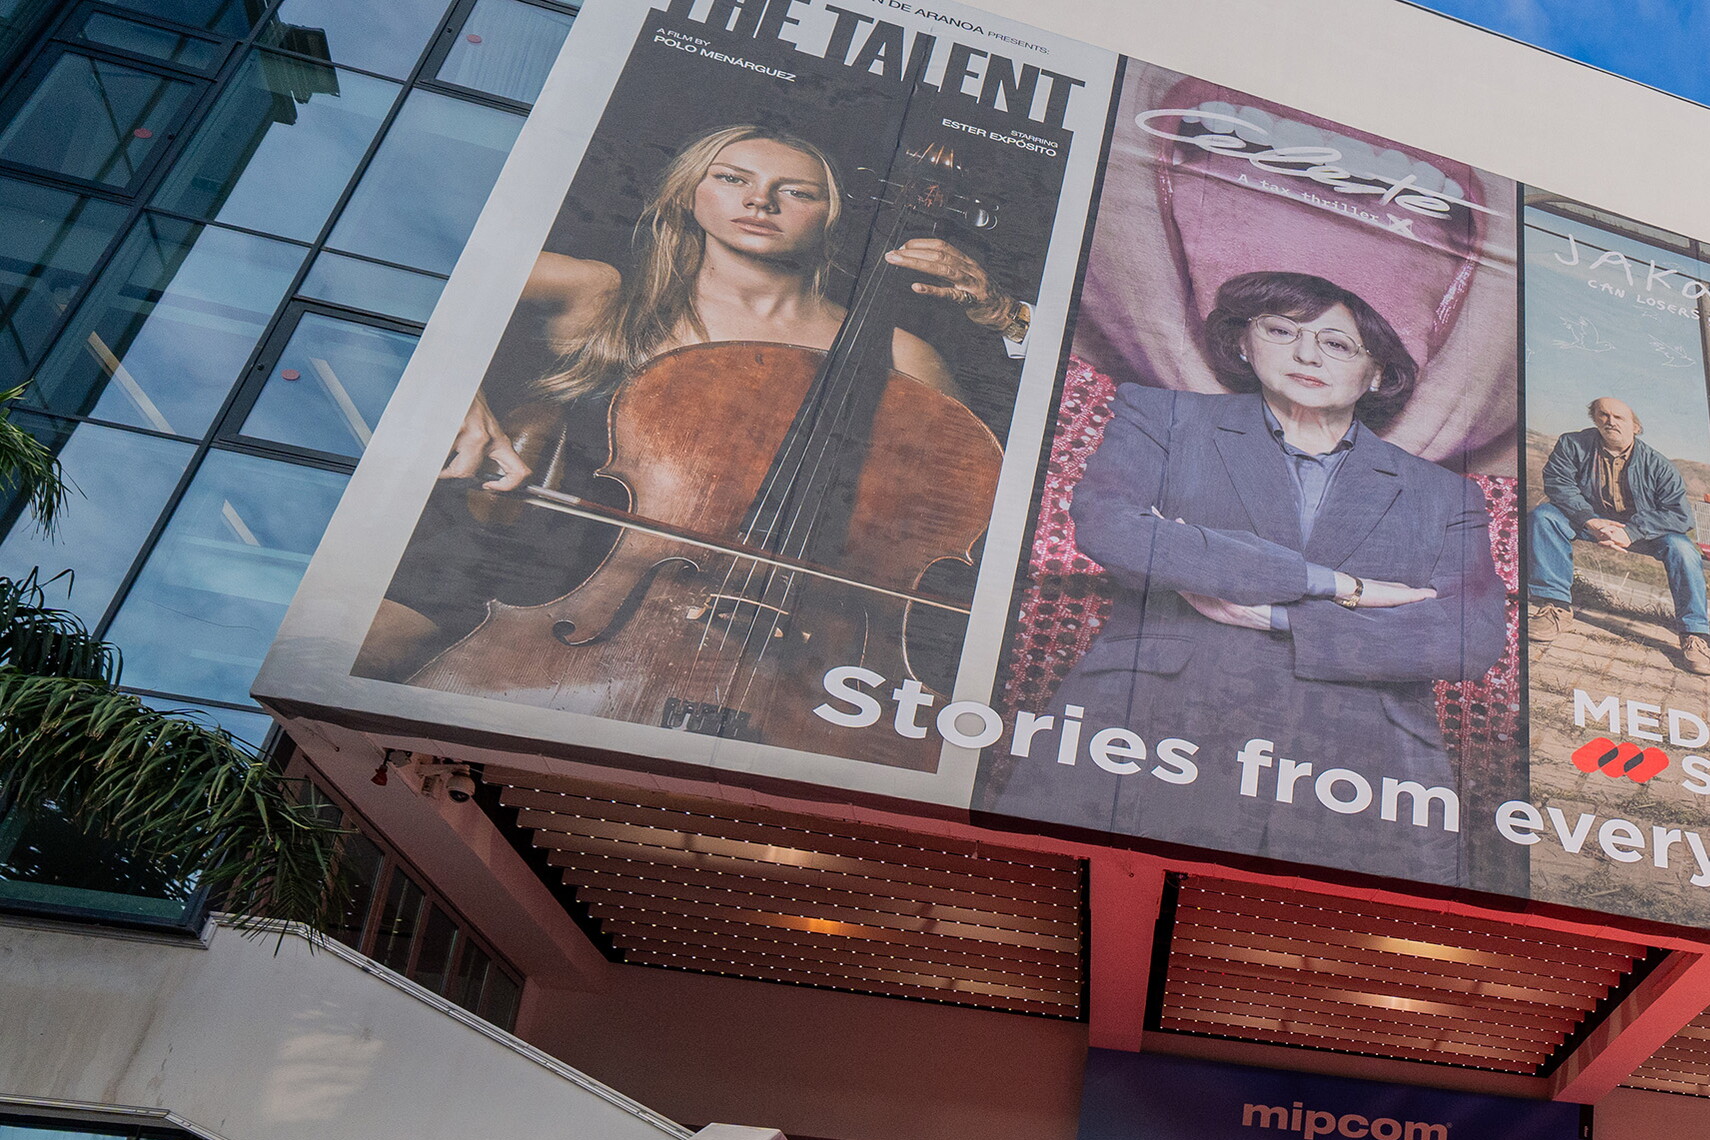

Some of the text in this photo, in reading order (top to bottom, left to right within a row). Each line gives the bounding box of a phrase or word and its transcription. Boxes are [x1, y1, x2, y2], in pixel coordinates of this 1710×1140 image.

[666, 30, 693, 43] FILM
[694, 38, 711, 46] BY
[887, 0, 1050, 55] DE ARANOA PRESENTS:
[653, 35, 797, 82] POLO MENÁRGUEZ
[822, 4, 1087, 130] TALENT
[942, 118, 1056, 157] ESTER EXPÓSITO
[1011, 130, 1059, 148] STARRING
[1238, 173, 1380, 223] A tax thriller
[1587, 278, 1626, 299] CAN
[1636, 294, 1701, 321] LOSERS
[812, 666, 1201, 786] Stories
[1236, 737, 1461, 833] from
